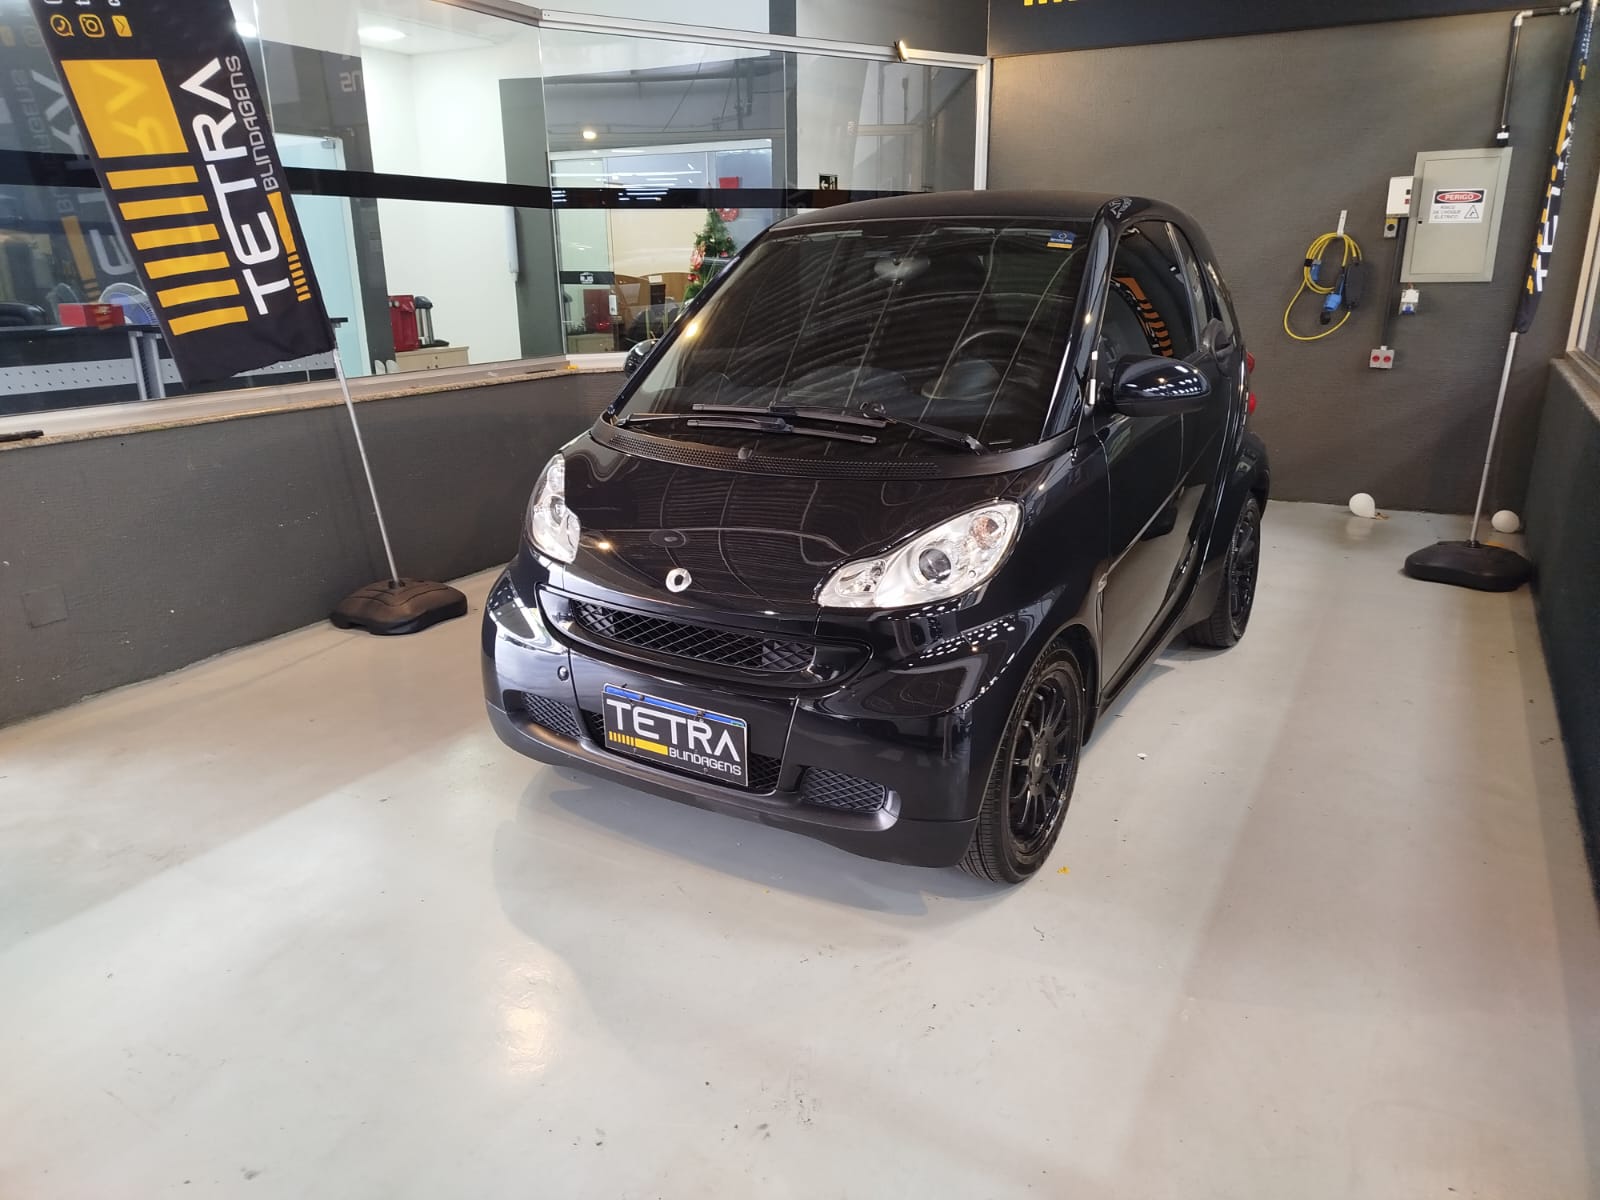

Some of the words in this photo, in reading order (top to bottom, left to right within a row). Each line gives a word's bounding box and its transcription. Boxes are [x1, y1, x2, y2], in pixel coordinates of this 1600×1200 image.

[225, 55, 280, 192] BLINDAGENS
[179, 57, 290, 315] TETRA
[607, 699, 740, 762] TETRA
[669, 747, 742, 776] BLINDAGENS
